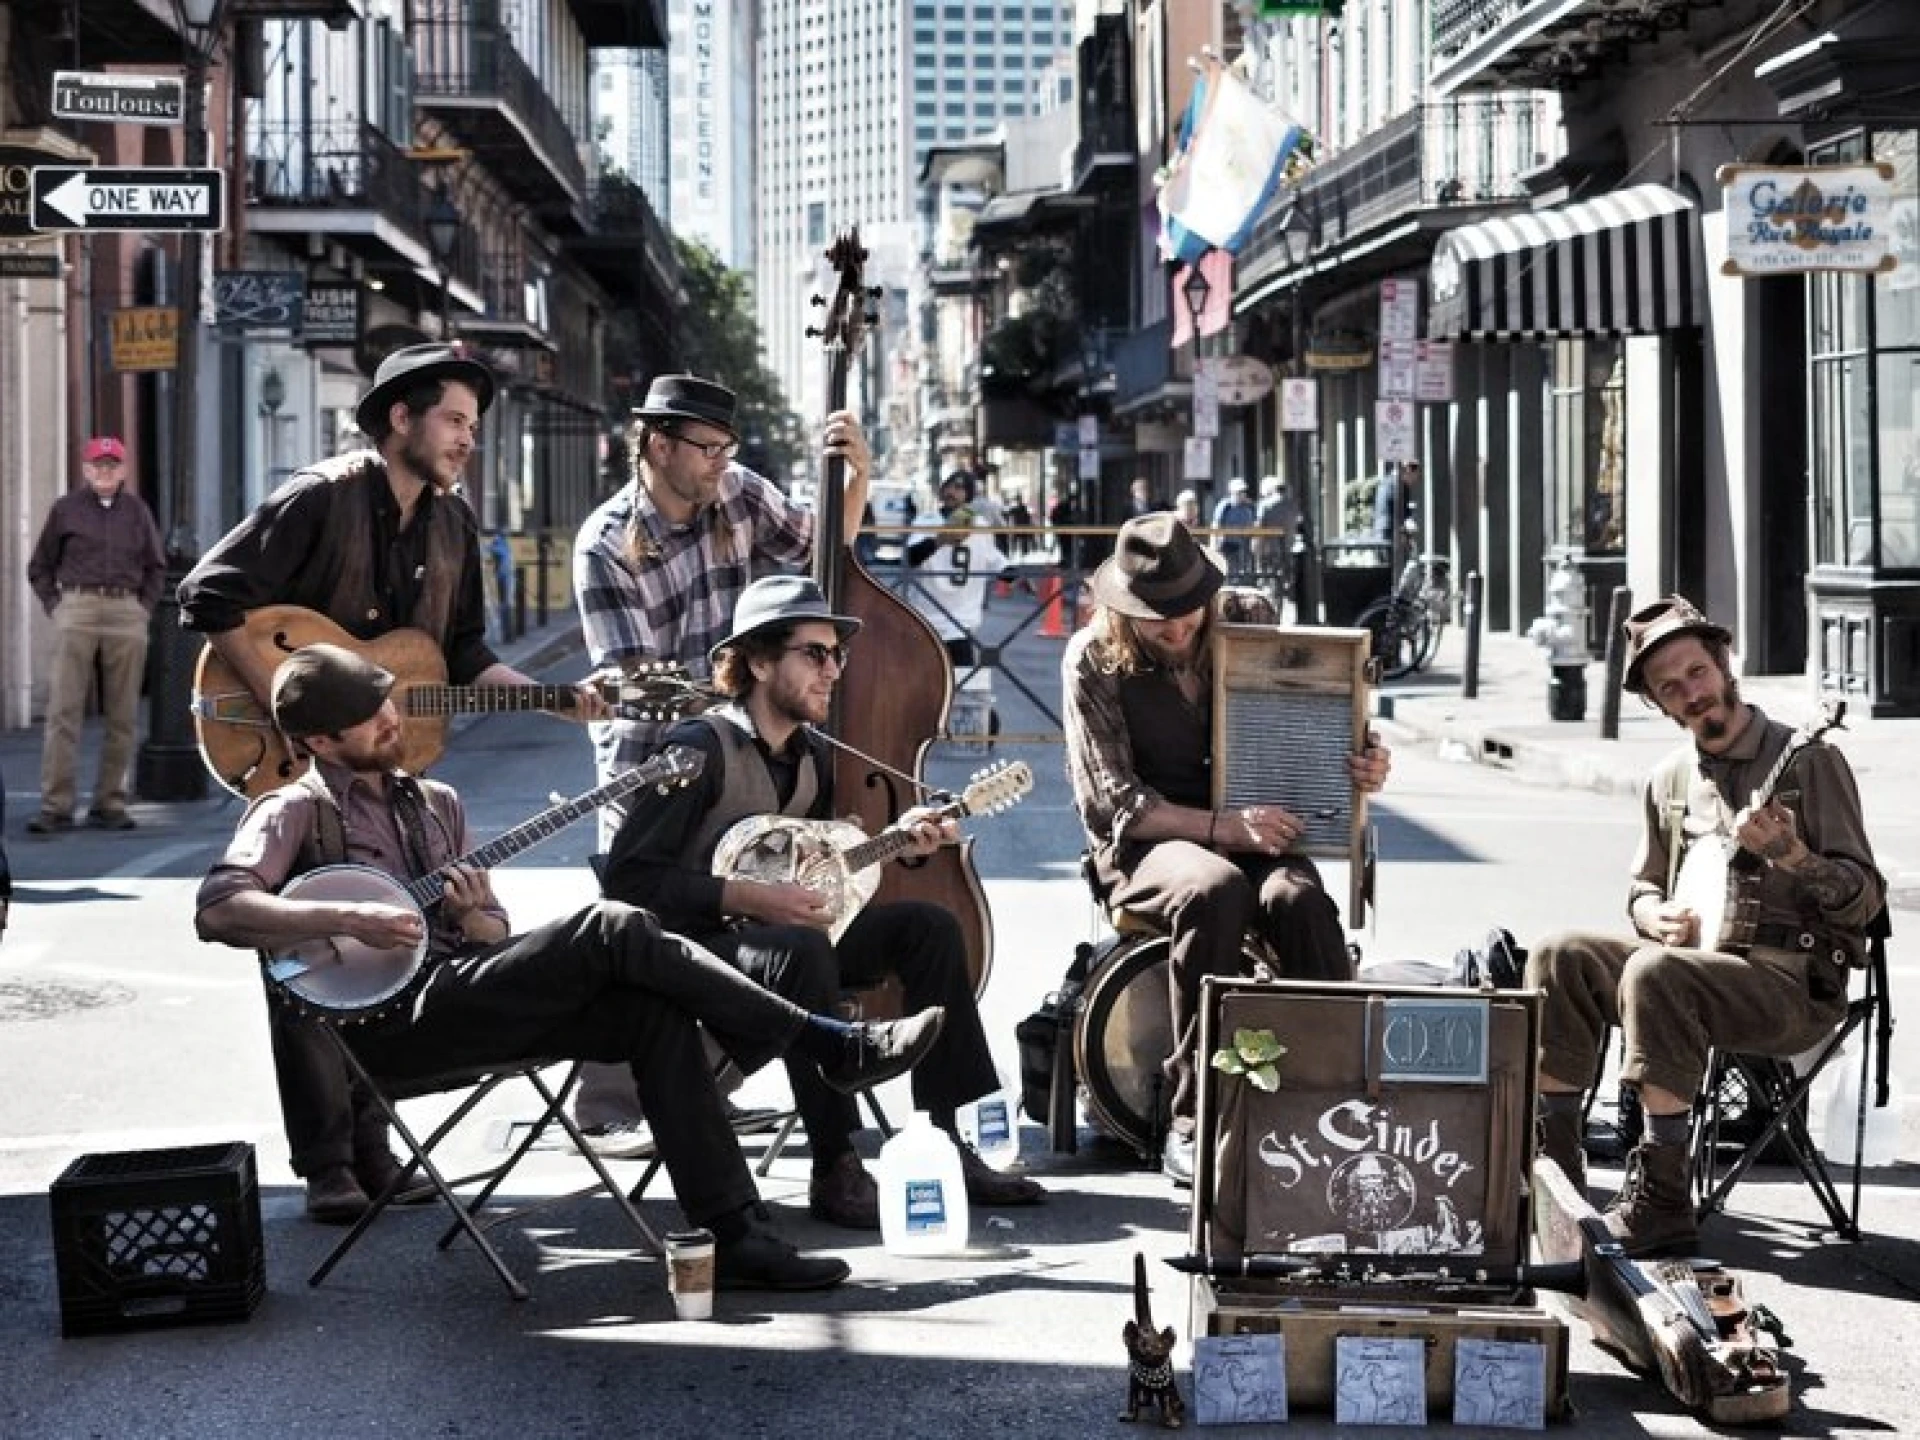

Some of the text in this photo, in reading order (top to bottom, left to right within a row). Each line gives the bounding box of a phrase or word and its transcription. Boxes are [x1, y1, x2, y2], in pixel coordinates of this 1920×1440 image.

[58, 87, 178, 115] Toulouse
[696, 4, 711, 198] MONTELEONE
[89, 187, 201, 212] ONE WAY
[949, 545, 970, 586] 9
[1259, 1098, 1475, 1188] St. Cinder
